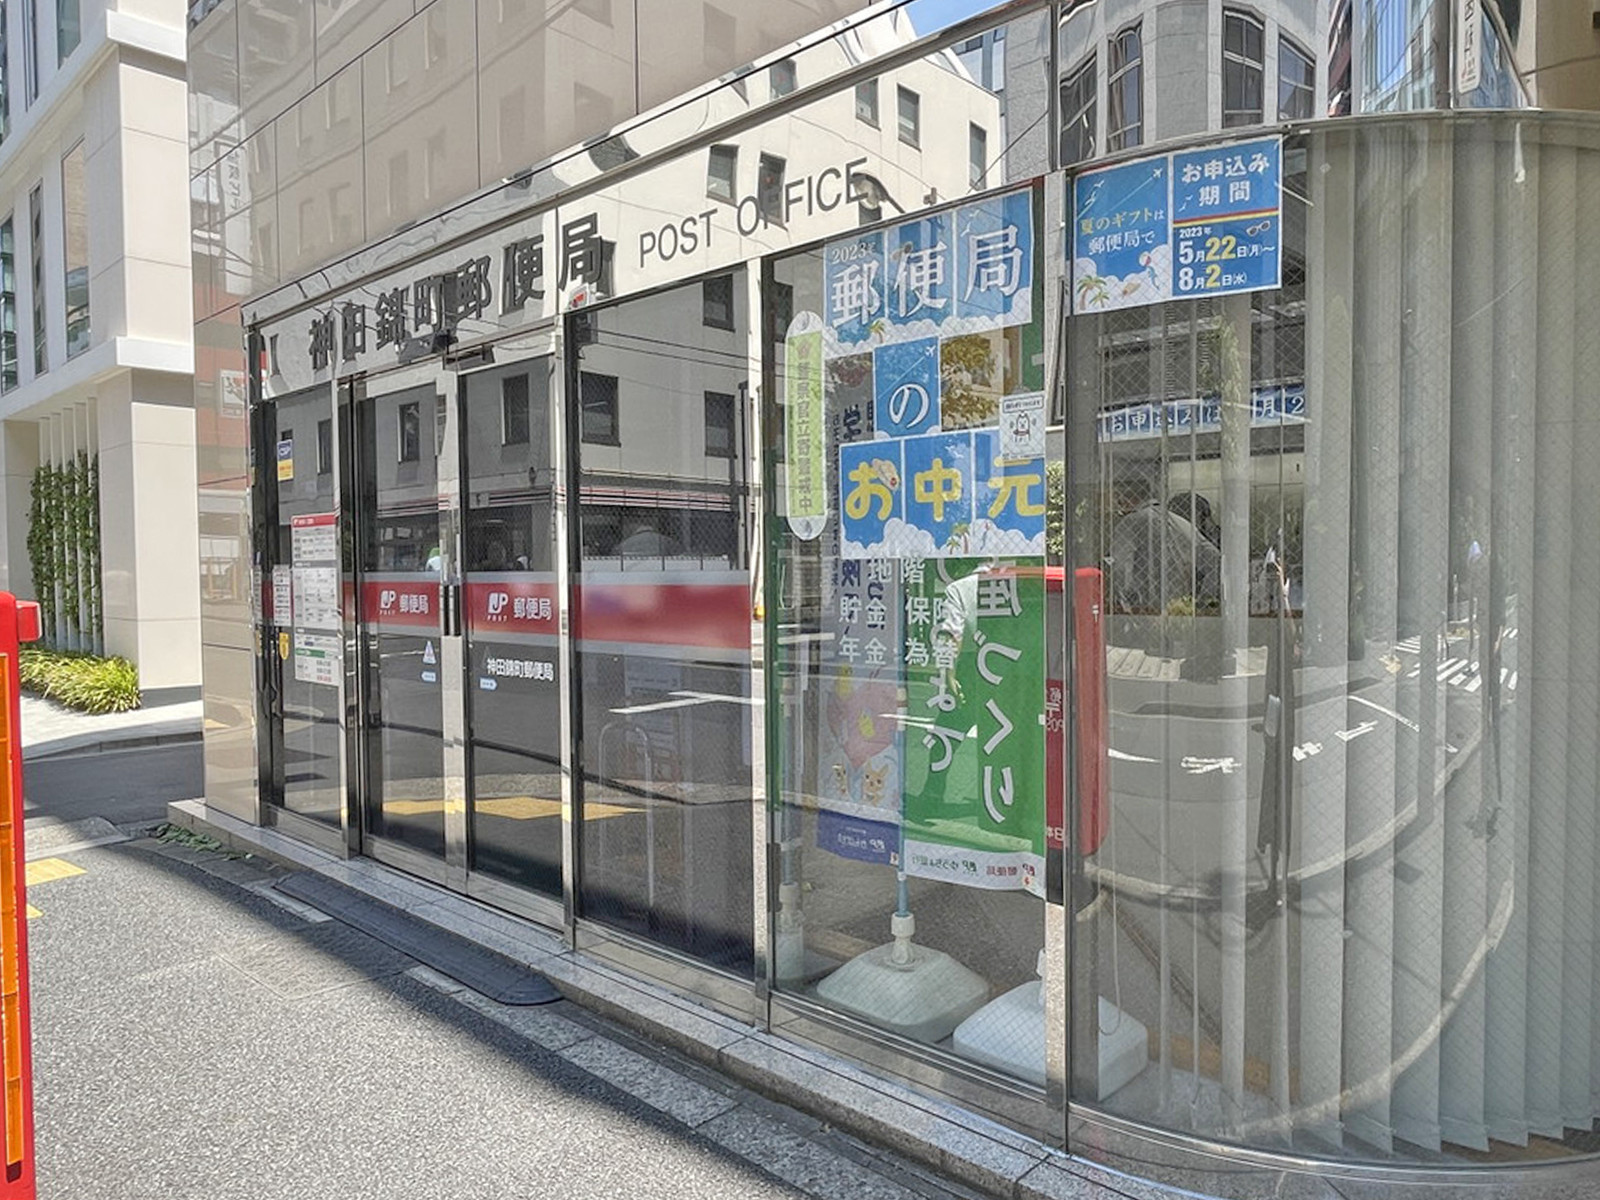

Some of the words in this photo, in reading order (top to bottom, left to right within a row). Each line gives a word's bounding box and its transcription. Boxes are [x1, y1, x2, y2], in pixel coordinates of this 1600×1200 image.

[1181, 152, 1271, 184] お申込み
[1198, 180, 1251, 207] 期間
[1080, 207, 1166, 235] 夏のギフトは
[1178, 226, 1213, 239] 2023年
[639, 208, 718, 268] POST
[1088, 229, 1156, 256] 郵便局で
[308, 212, 604, 362] 神田錦町郵便局
[831, 224, 1024, 328] 郵便局
[889, 383, 928, 427] の
[846, 456, 1045, 522] お中元
[399, 593, 430, 615] 郵便局
[513, 597, 553, 621] 郵便局
[486, 657, 554, 682] 神田錦町郵便局
